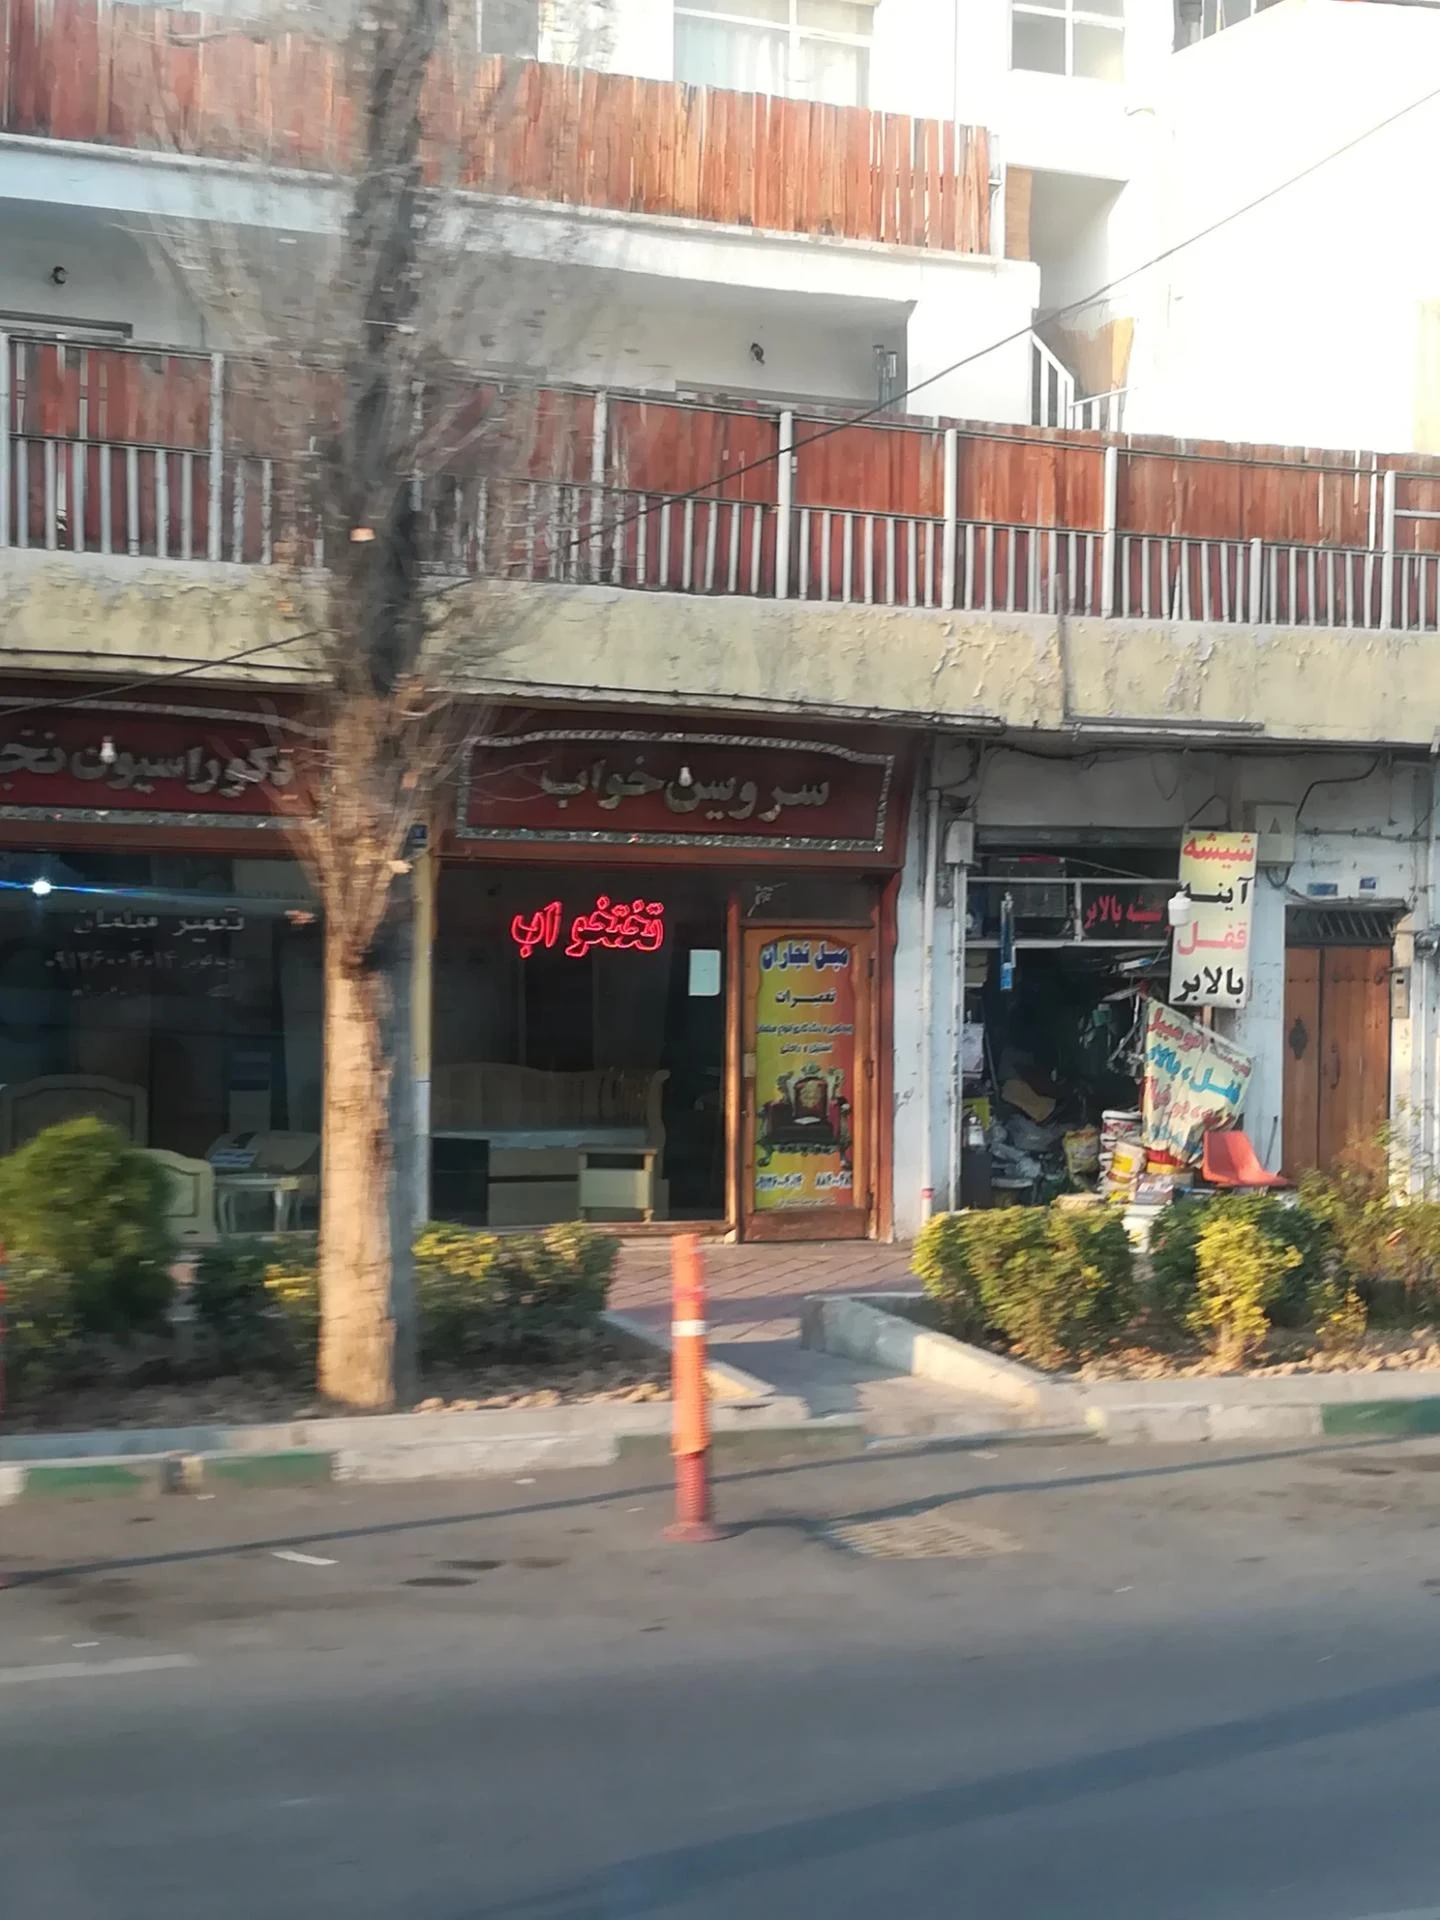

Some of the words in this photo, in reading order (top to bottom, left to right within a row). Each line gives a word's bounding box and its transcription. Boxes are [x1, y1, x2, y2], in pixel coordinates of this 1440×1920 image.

[539, 755, 666, 810] خواب
[664, 777, 830, 823] سرویس
[1183, 833, 1255, 869] شیشه
[1084, 895, 1123, 929] بالابر
[1170, 877, 1254, 912] آینه
[172, 907, 245, 943] تعمیر
[1176, 920, 1248, 956] قفل
[814, 941, 849, 972] مبل
[775, 987, 837, 1009] تعمیرات
[1173, 966, 1245, 1004] بالابر
